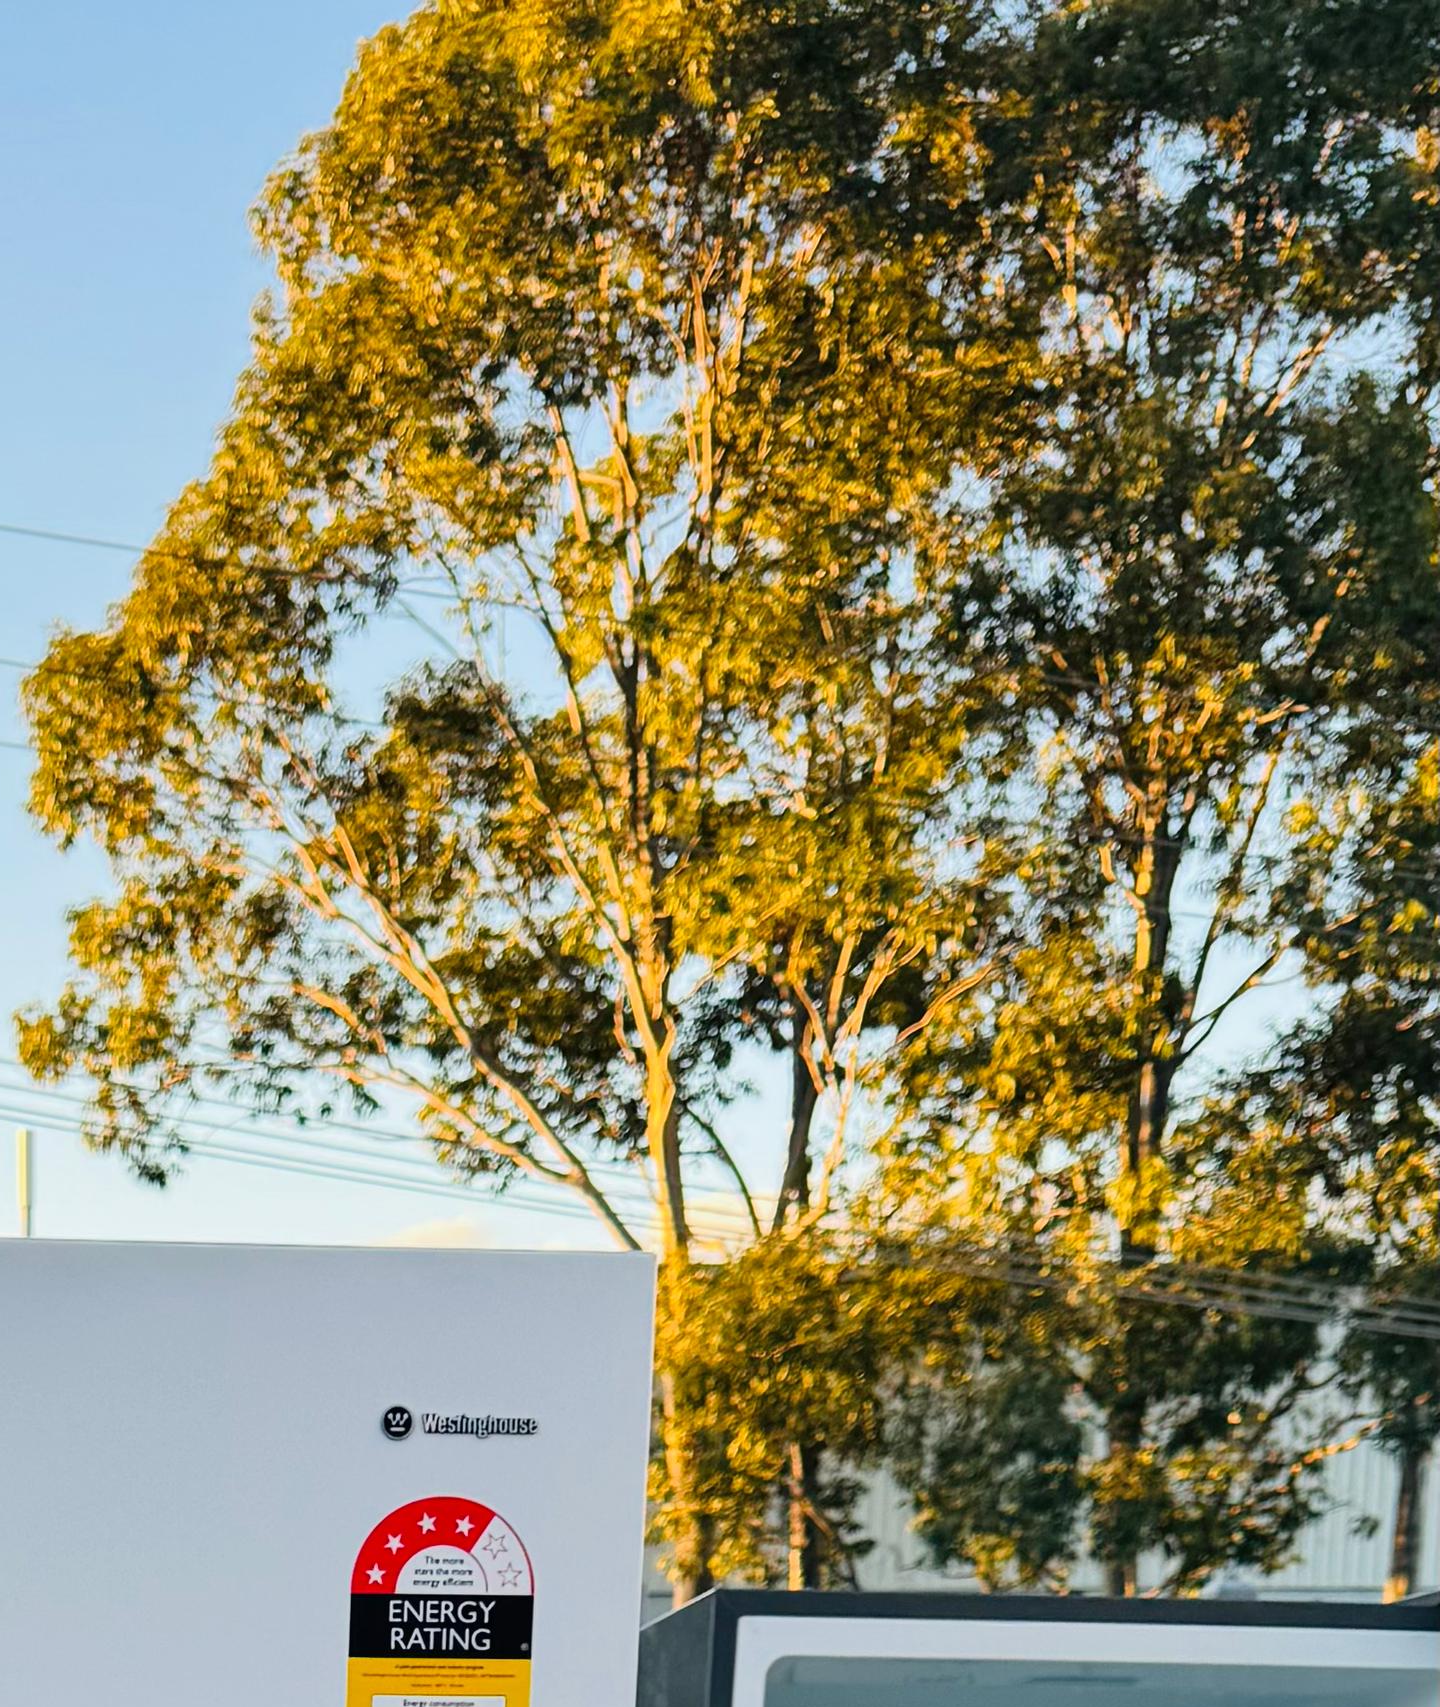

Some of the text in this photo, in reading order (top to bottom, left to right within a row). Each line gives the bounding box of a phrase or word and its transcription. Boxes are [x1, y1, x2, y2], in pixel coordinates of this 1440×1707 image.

[422, 1413, 538, 1439] Westinghouse
[388, 1600, 496, 1623] ENERGY
[390, 1627, 491, 1650] RATING
